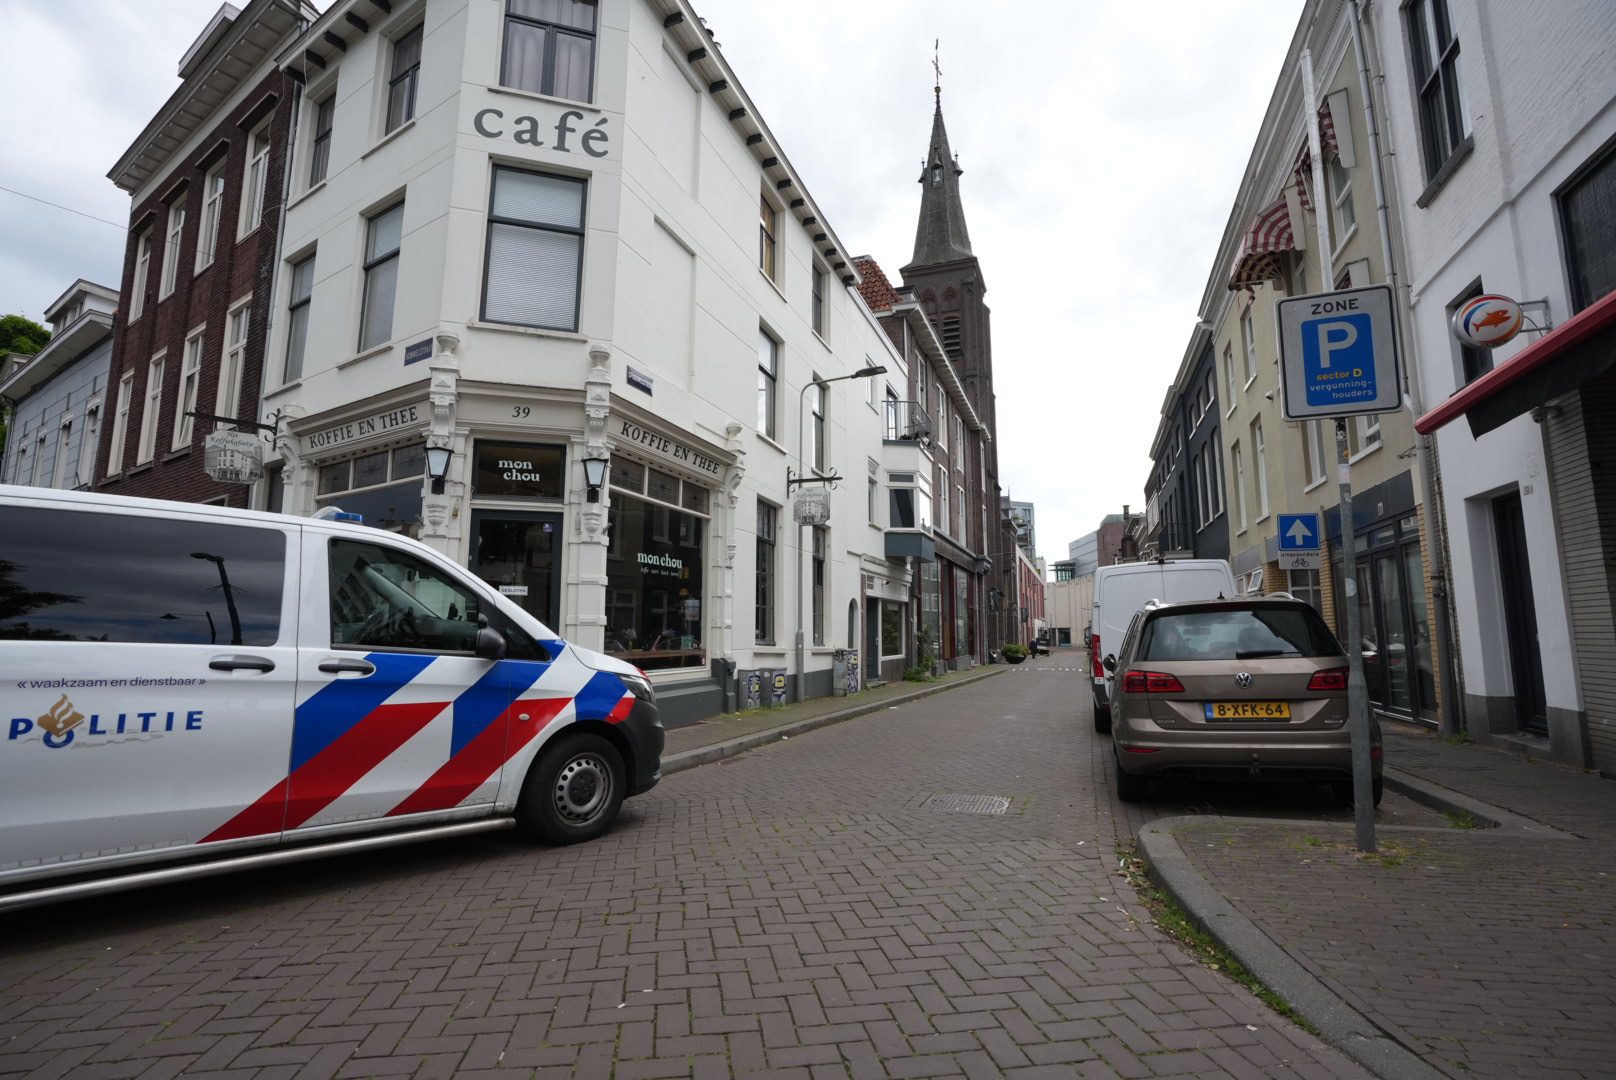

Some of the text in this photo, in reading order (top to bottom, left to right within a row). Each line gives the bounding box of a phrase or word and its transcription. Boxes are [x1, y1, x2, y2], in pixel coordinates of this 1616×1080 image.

[473, 108, 609, 158] café
[1311, 298, 1359, 315] ZONE
[1317, 321, 1358, 369] P
[1316, 368, 1362, 381] sector D
[1310, 380, 1373, 392] vergunning-
[1332, 389, 1374, 399] houders
[512, 406, 531, 418] 39
[309, 406, 419, 449] KOFFIE EN THEE
[620, 421, 720, 474] KOFFIE EN THEE
[498, 460, 533, 470] mon
[503, 469, 540, 482] chou
[637, 552, 683, 569] mon chou
[30, 678, 107, 689] waakzaam
[110, 679, 127, 688] en
[129, 676, 197, 687] dienstbaar
[1217, 704, 1284, 716] 8-XFK-64
[8, 711, 204, 749] POLITIE
